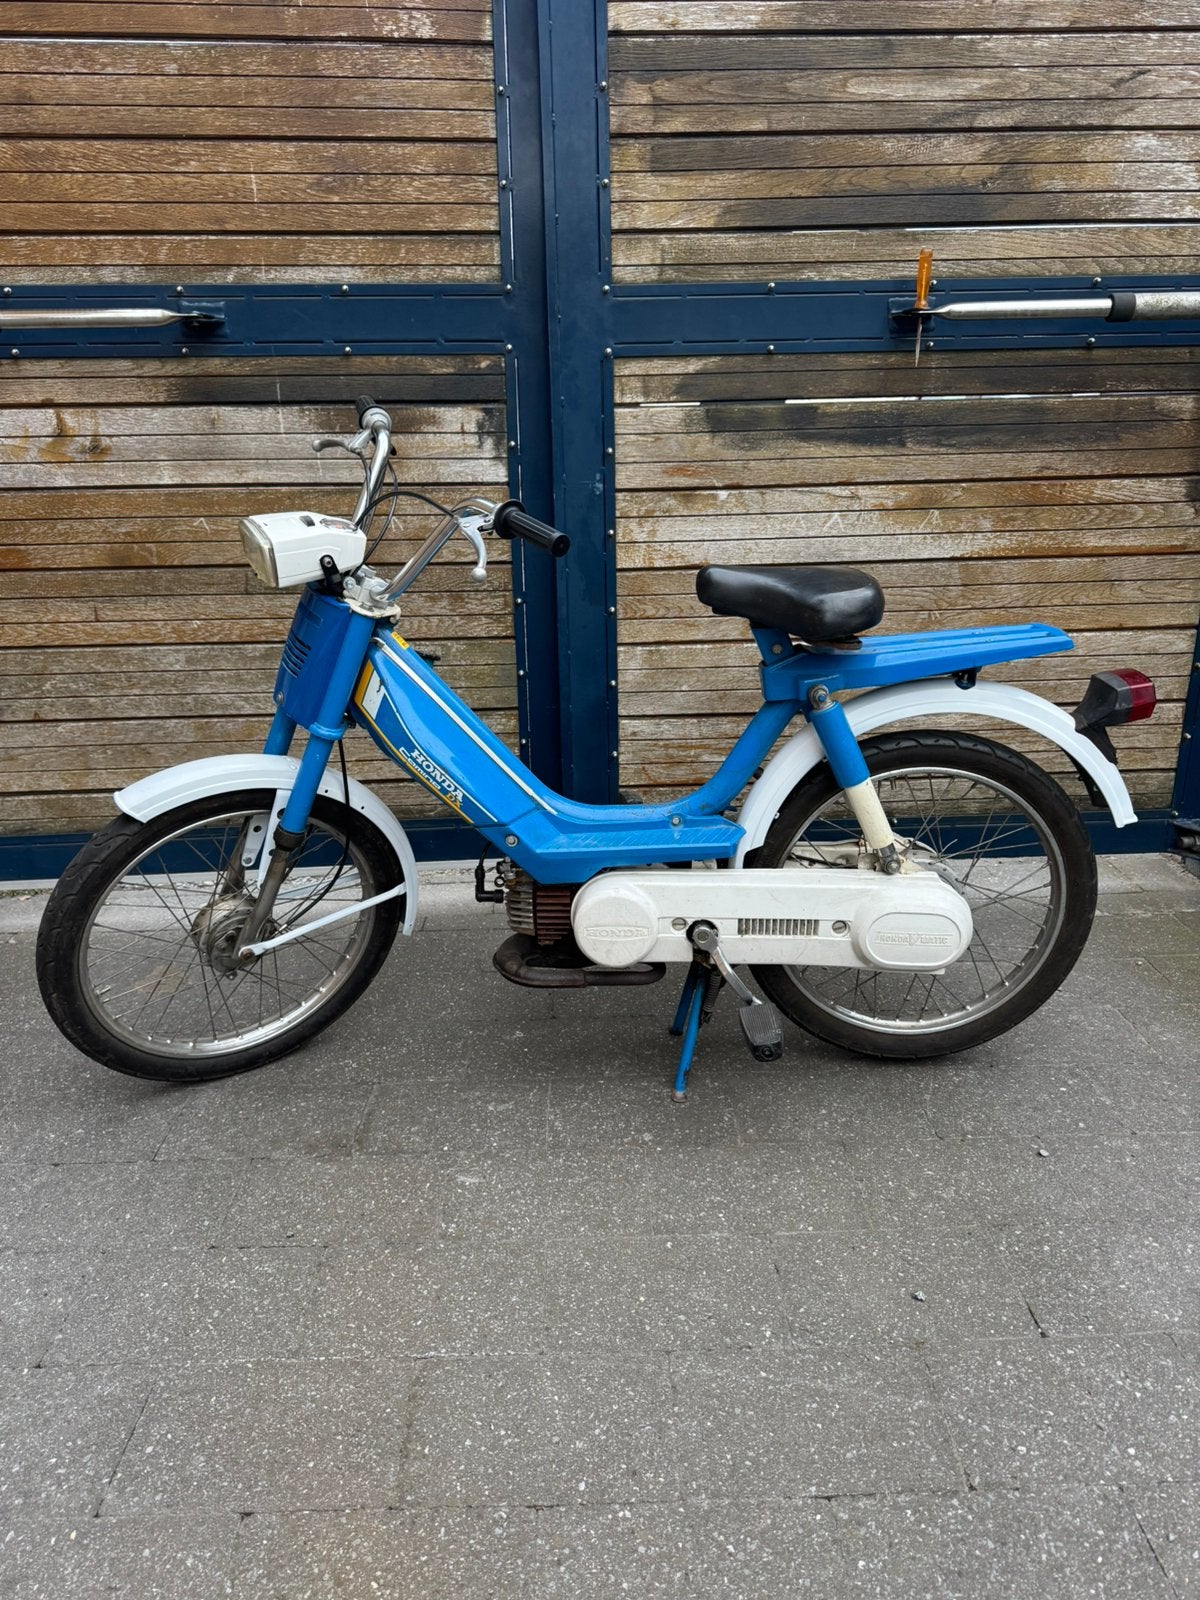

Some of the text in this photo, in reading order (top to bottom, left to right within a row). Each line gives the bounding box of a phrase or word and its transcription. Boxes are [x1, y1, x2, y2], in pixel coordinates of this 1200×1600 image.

[399, 746, 441, 790] Camino
[410, 748, 464, 802] HONDA
[585, 928, 647, 938] HONDA
